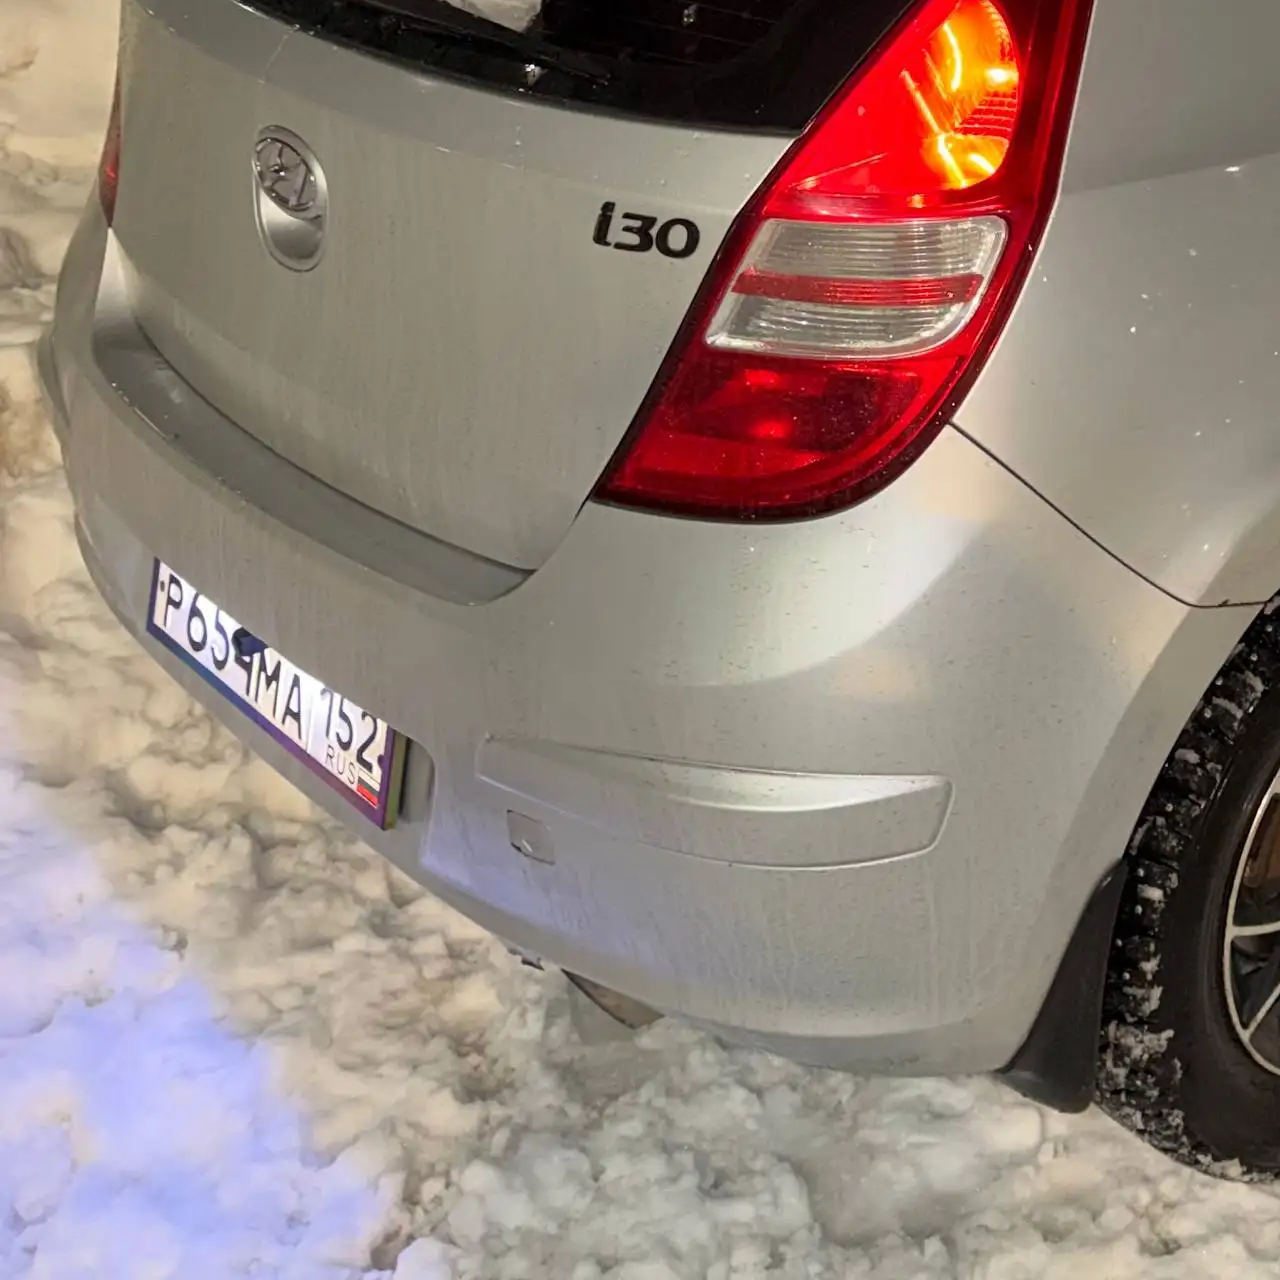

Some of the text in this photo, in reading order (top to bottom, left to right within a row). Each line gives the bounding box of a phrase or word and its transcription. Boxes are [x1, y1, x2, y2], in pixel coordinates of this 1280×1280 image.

[593, 201, 700, 258] i30
[320, 687, 378, 774] 152
[325, 744, 356, 785] RUS
